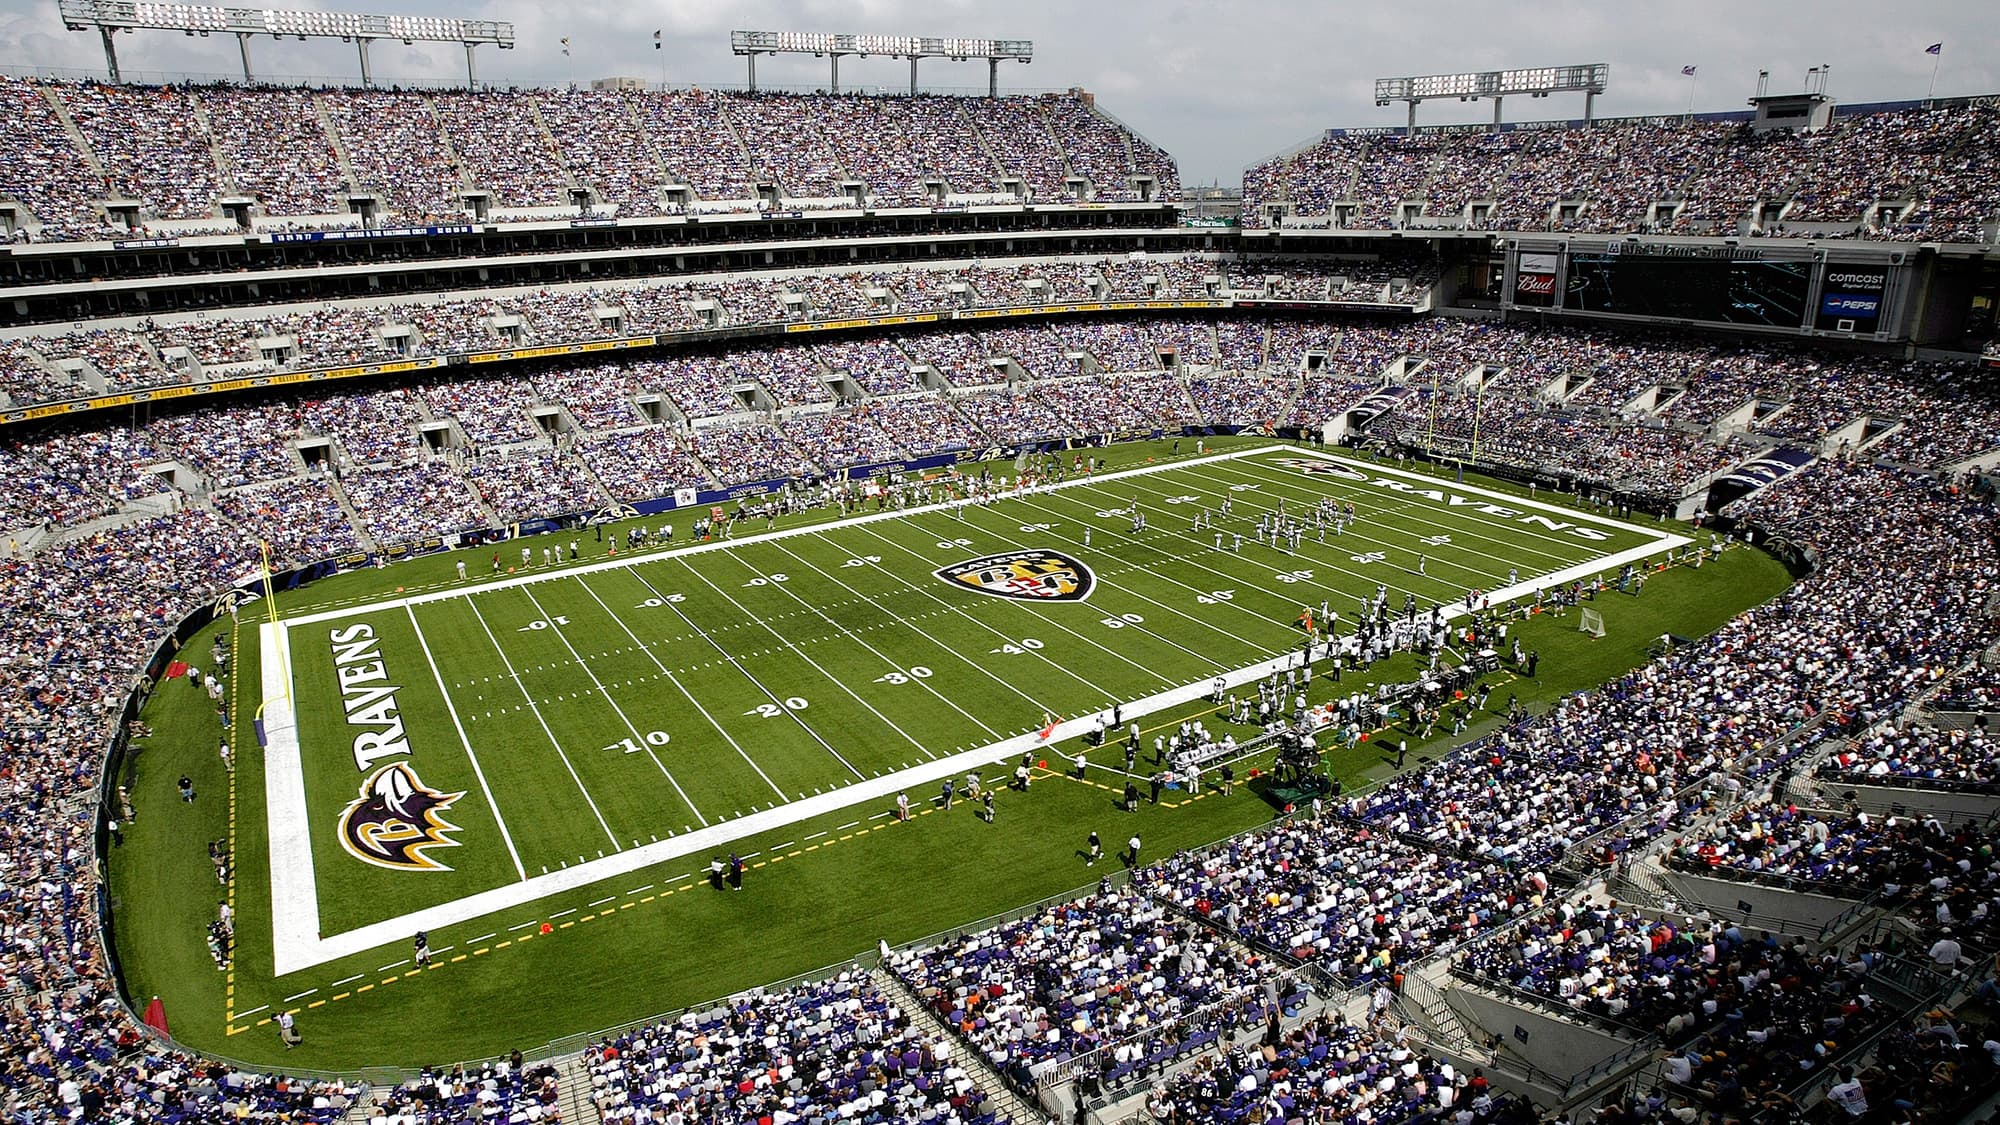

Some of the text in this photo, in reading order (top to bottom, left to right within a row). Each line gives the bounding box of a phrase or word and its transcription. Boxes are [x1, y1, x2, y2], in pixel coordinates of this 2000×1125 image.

[1517, 274, 1555, 291] Bud
[1829, 273, 1885, 284] comcast
[1841, 300, 1878, 310] PEPSI
[1368, 477, 1615, 541] RAVENS
[948, 552, 1045, 575] RAVENS
[1350, 552, 1385, 564] 20
[1276, 570, 1312, 584] 30
[1197, 590, 1234, 604] 40
[1100, 613, 1144, 629] 50
[1003, 638, 1045, 655] 40
[883, 666, 933, 685] 30
[329, 623, 413, 772] RAVENS
[756, 697, 809, 718] 20
[619, 731, 670, 753] 10
[357, 818, 425, 856] B
[1201, 1087, 1213, 1097] 86
